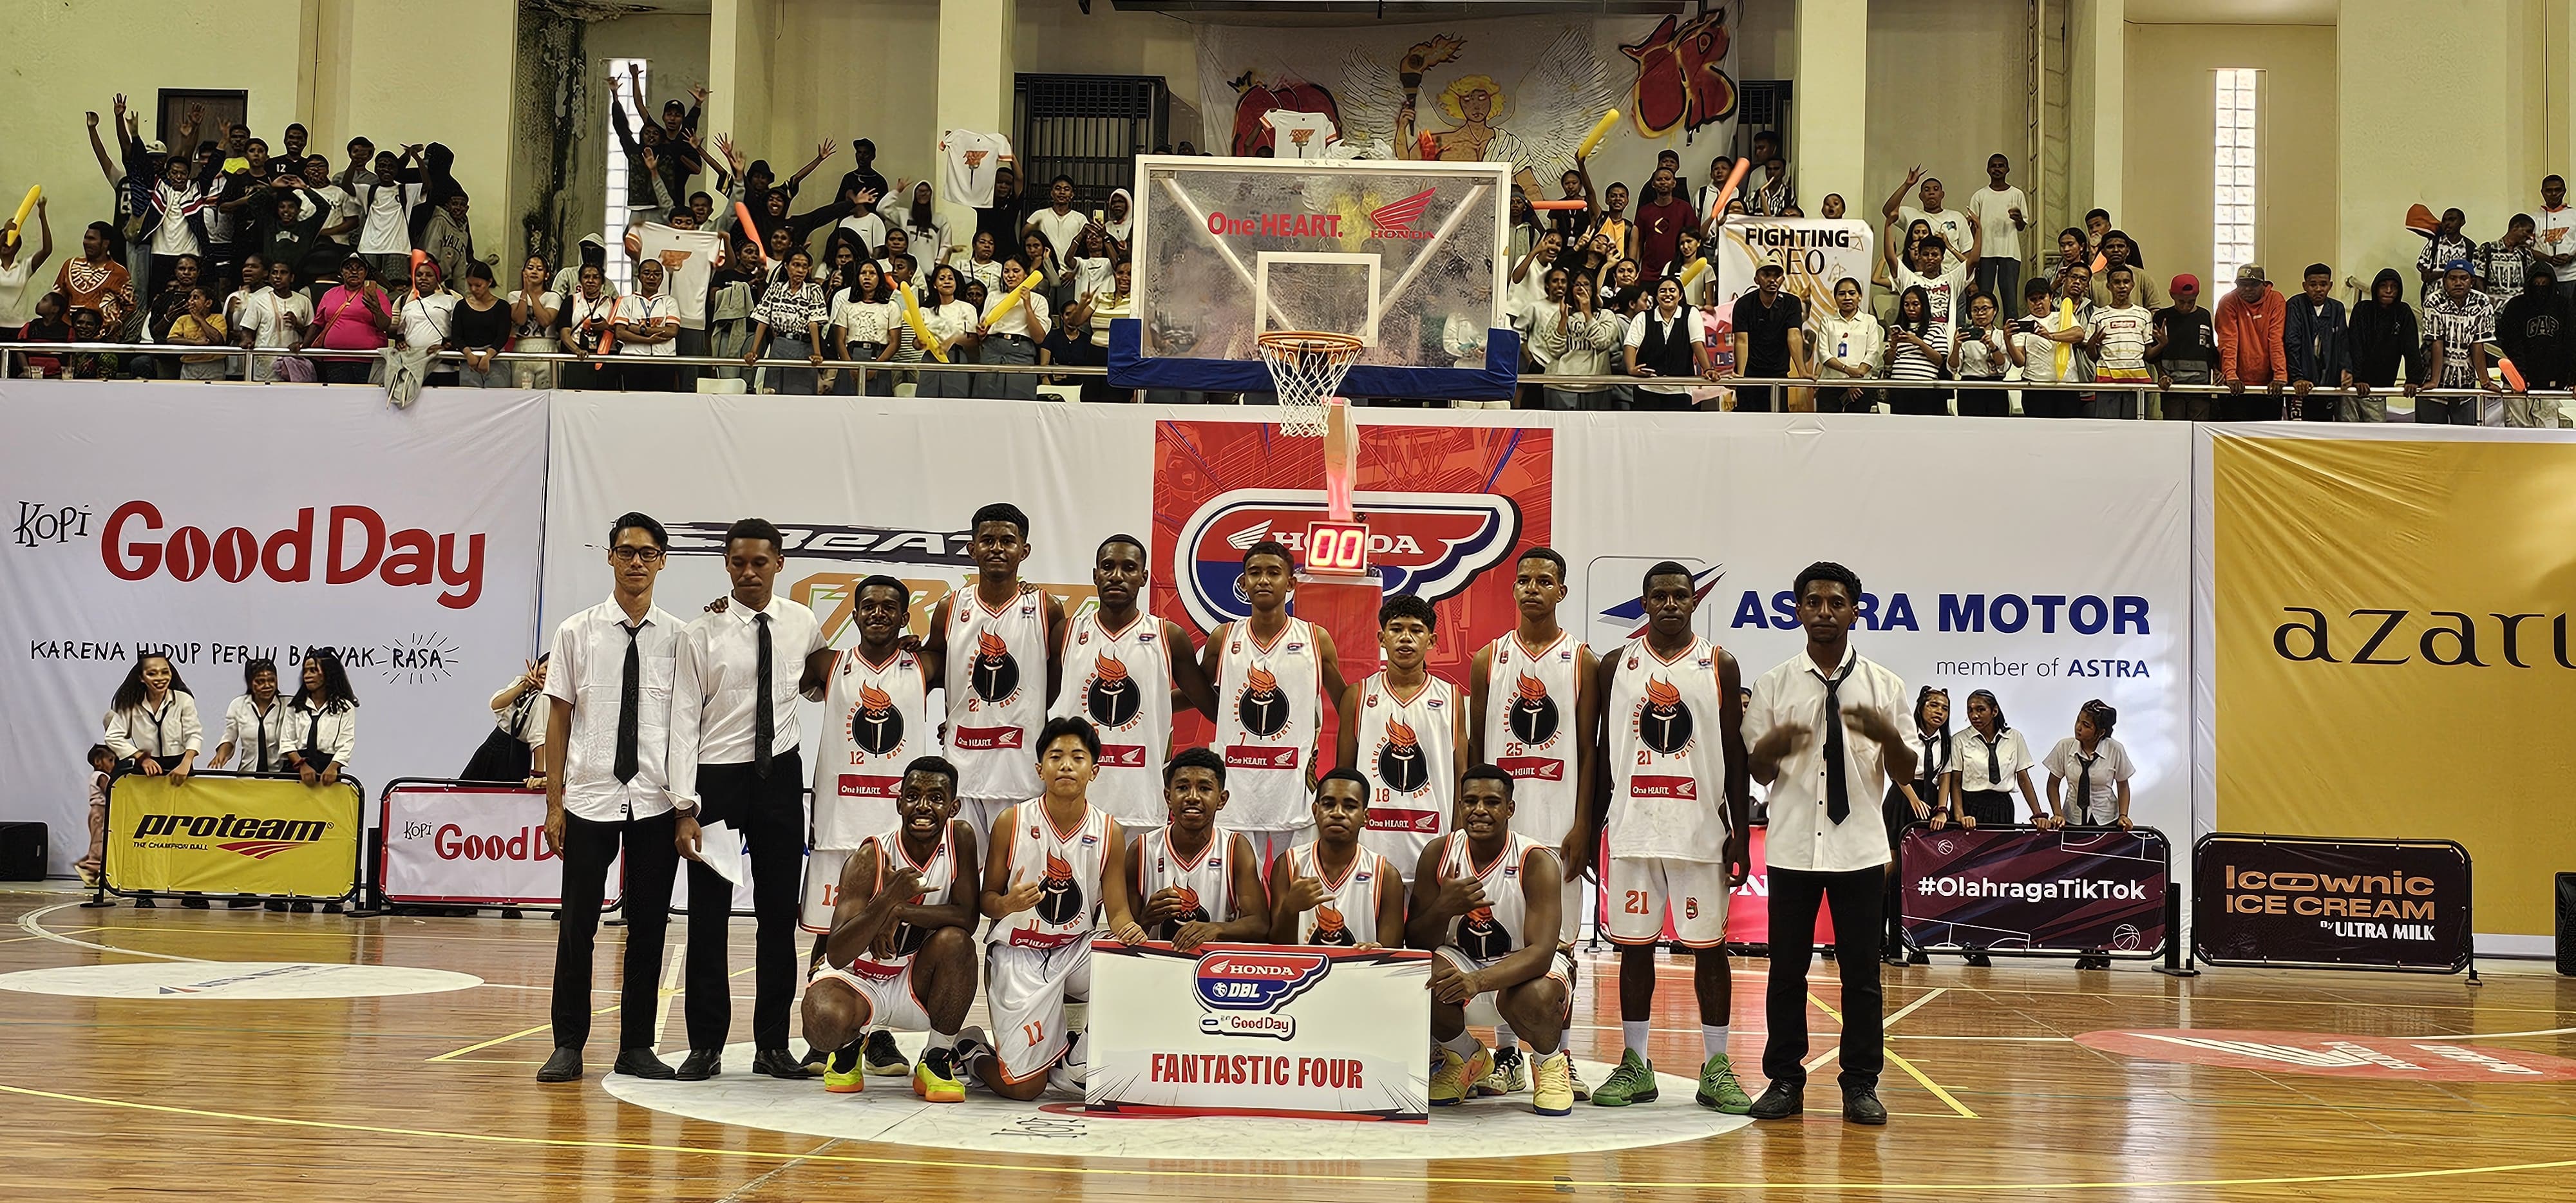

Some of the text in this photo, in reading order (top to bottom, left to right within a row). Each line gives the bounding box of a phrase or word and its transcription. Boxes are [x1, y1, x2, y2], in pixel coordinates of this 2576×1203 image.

[1208, 211, 1255, 235] One
[1370, 230, 1435, 239] HONDA
[1745, 227, 1850, 247] FIGHTING
[1272, 532, 1424, 554] HDA
[1309, 528, 1365, 567] 00
[101, 500, 315, 583] Good
[326, 505, 486, 609] Day
[1730, 591, 2150, 634] ASRA MOTOR
[30, 639, 126, 661] KARENA
[392, 648, 443, 669] RASA
[1936, 656, 2150, 678] member of ASTRA
[850, 751, 864, 764] 12
[1506, 743, 1522, 756] 25
[1638, 750, 1651, 765] 21
[1376, 788, 1390, 802] 18
[434, 823, 529, 861] Good
[1918, 876, 2146, 903] #OlahragaTikTok
[1625, 890, 1649, 914] 21
[2226, 895, 2435, 920] ICE CREAM
[2335, 921, 2388, 939] ULTRA
[2392, 924, 2436, 941] MILK
[1229, 963, 1295, 976] HONDA
[1227, 982, 1262, 998] DBL
[1023, 1020, 1045, 1047] 11
[1231, 1015, 1264, 1028] Good
[1265, 1017, 1289, 1033] Day
[1150, 1053, 1363, 1089] FANTASTIC FOUR
